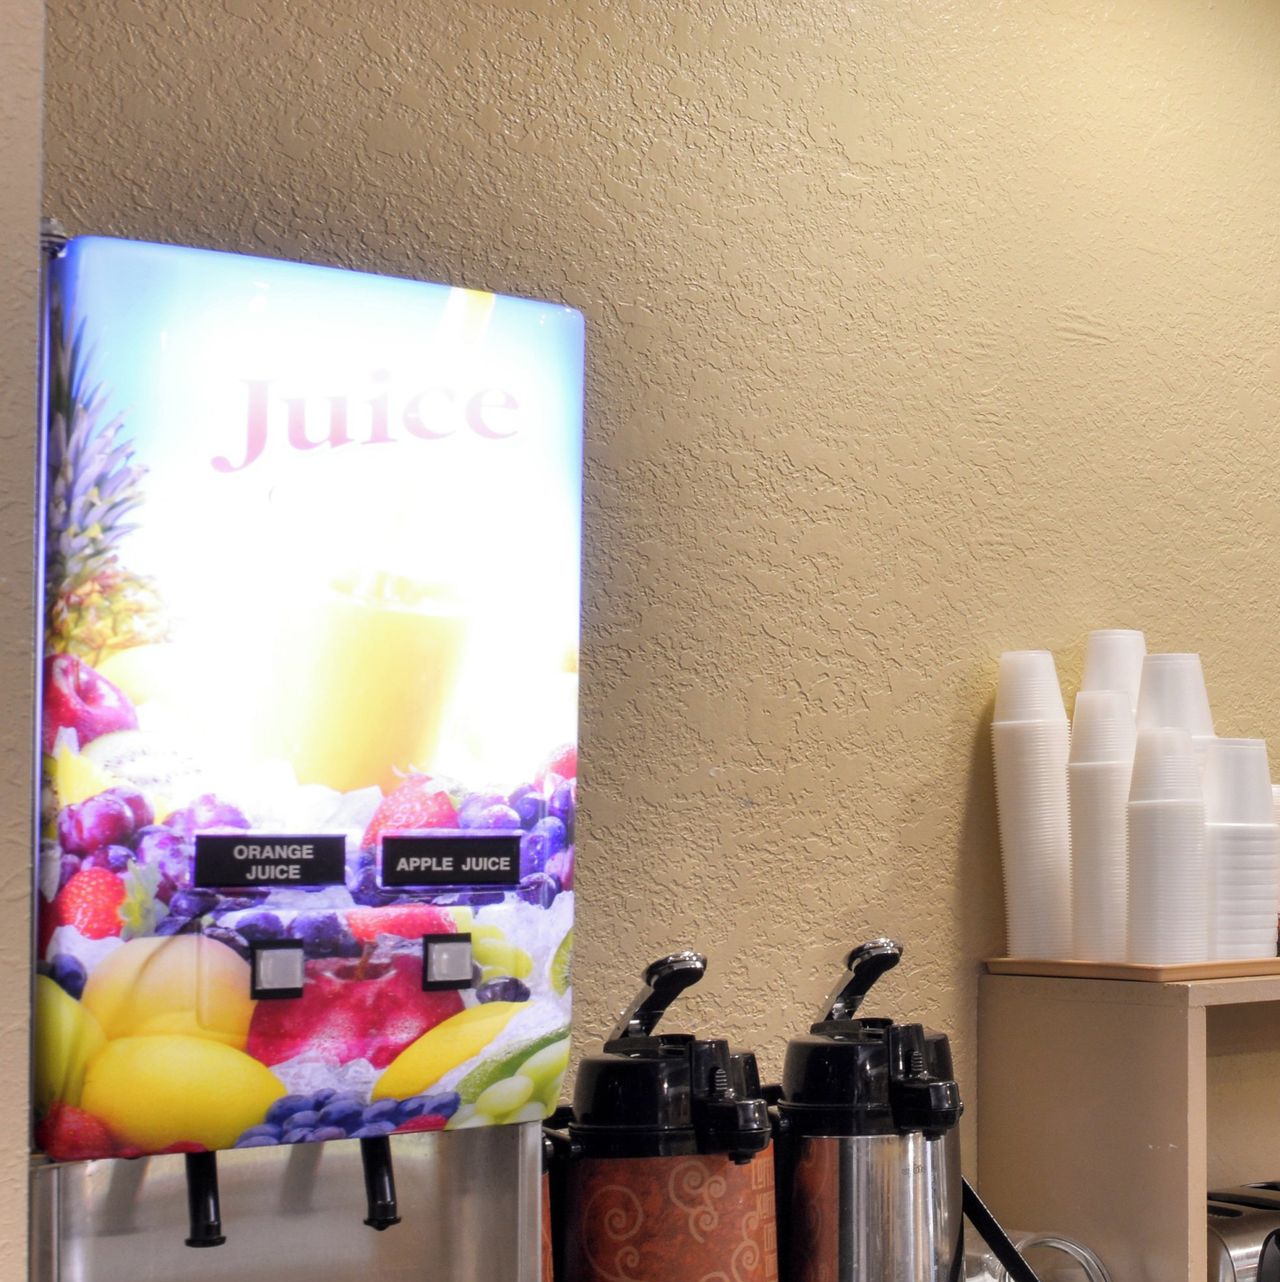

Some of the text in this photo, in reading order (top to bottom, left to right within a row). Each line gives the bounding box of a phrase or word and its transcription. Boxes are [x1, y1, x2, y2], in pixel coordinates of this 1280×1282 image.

[210, 368, 520, 473] Juice
[233, 845, 314, 860] ORANGE
[396, 857, 510, 871] APPLE JUICE
[246, 865, 300, 880] JUICE
